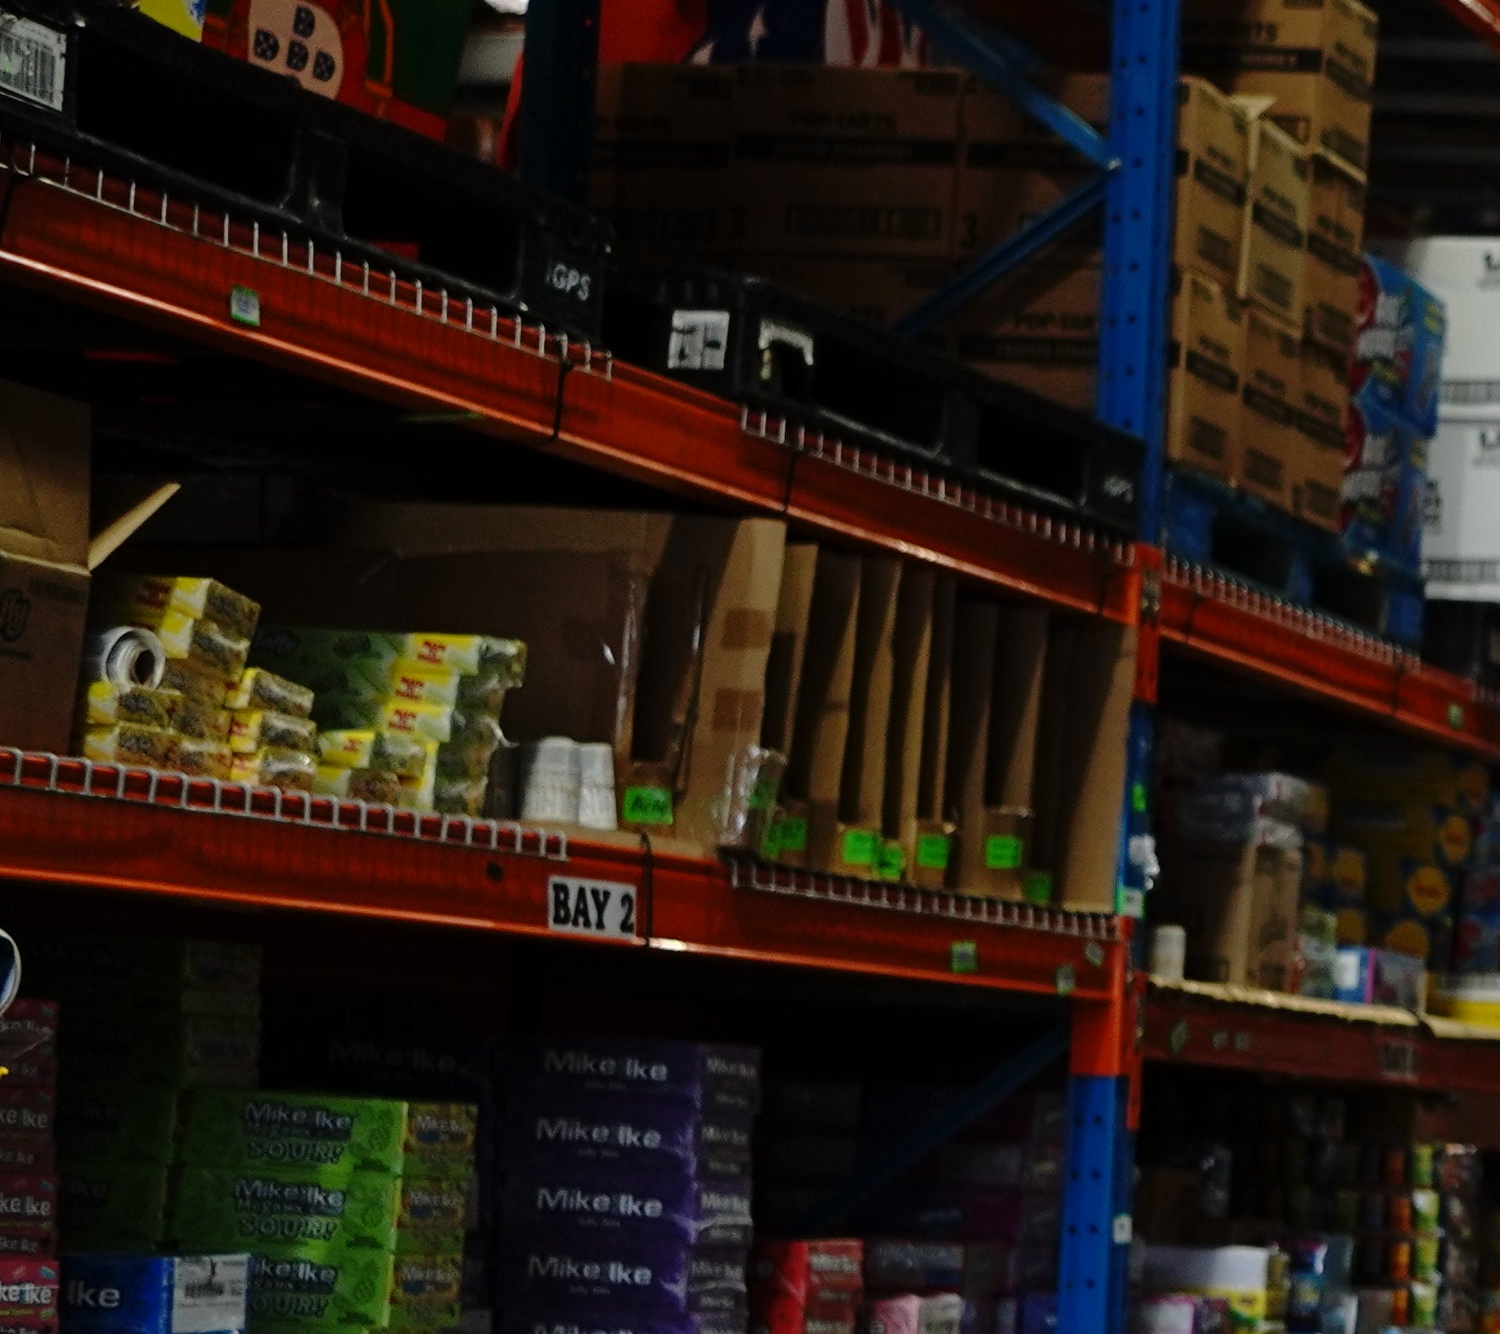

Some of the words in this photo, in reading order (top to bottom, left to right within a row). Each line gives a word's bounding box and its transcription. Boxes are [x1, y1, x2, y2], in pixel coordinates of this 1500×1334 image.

[552, 883, 611, 930] BAY
[619, 893, 636, 933] 2
[536, 1118, 611, 1144] Mike
[617, 1124, 663, 1150] Ike
[537, 1187, 612, 1213] Mike
[618, 1193, 664, 1219] Ike
[527, 1255, 602, 1280] Mike
[608, 1261, 653, 1286] Ike
[66, 1280, 122, 1308] Ike
